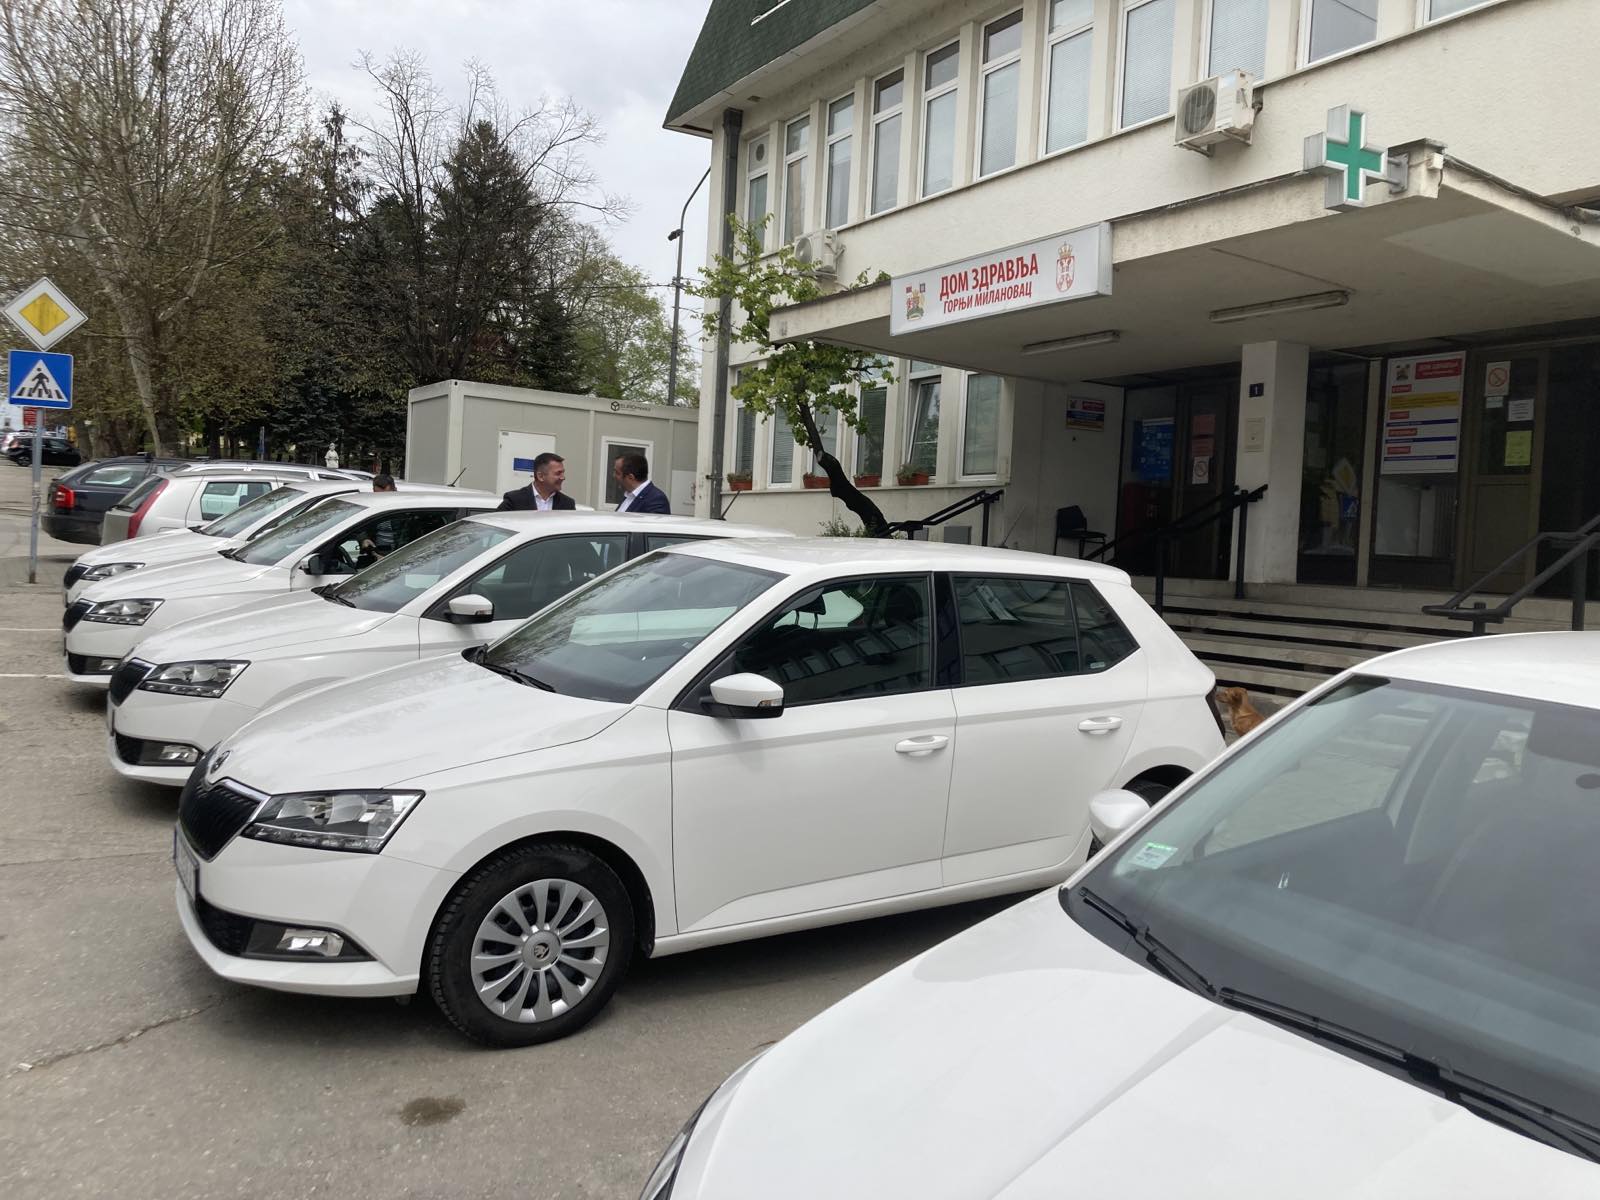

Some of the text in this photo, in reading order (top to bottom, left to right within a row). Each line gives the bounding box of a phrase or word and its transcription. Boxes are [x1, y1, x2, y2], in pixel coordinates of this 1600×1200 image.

[940, 253, 1039, 301] ДОМ ЗДРАВЉА
[943, 281, 1032, 314] ГОРЊИ МИЛАНОВАЦ
